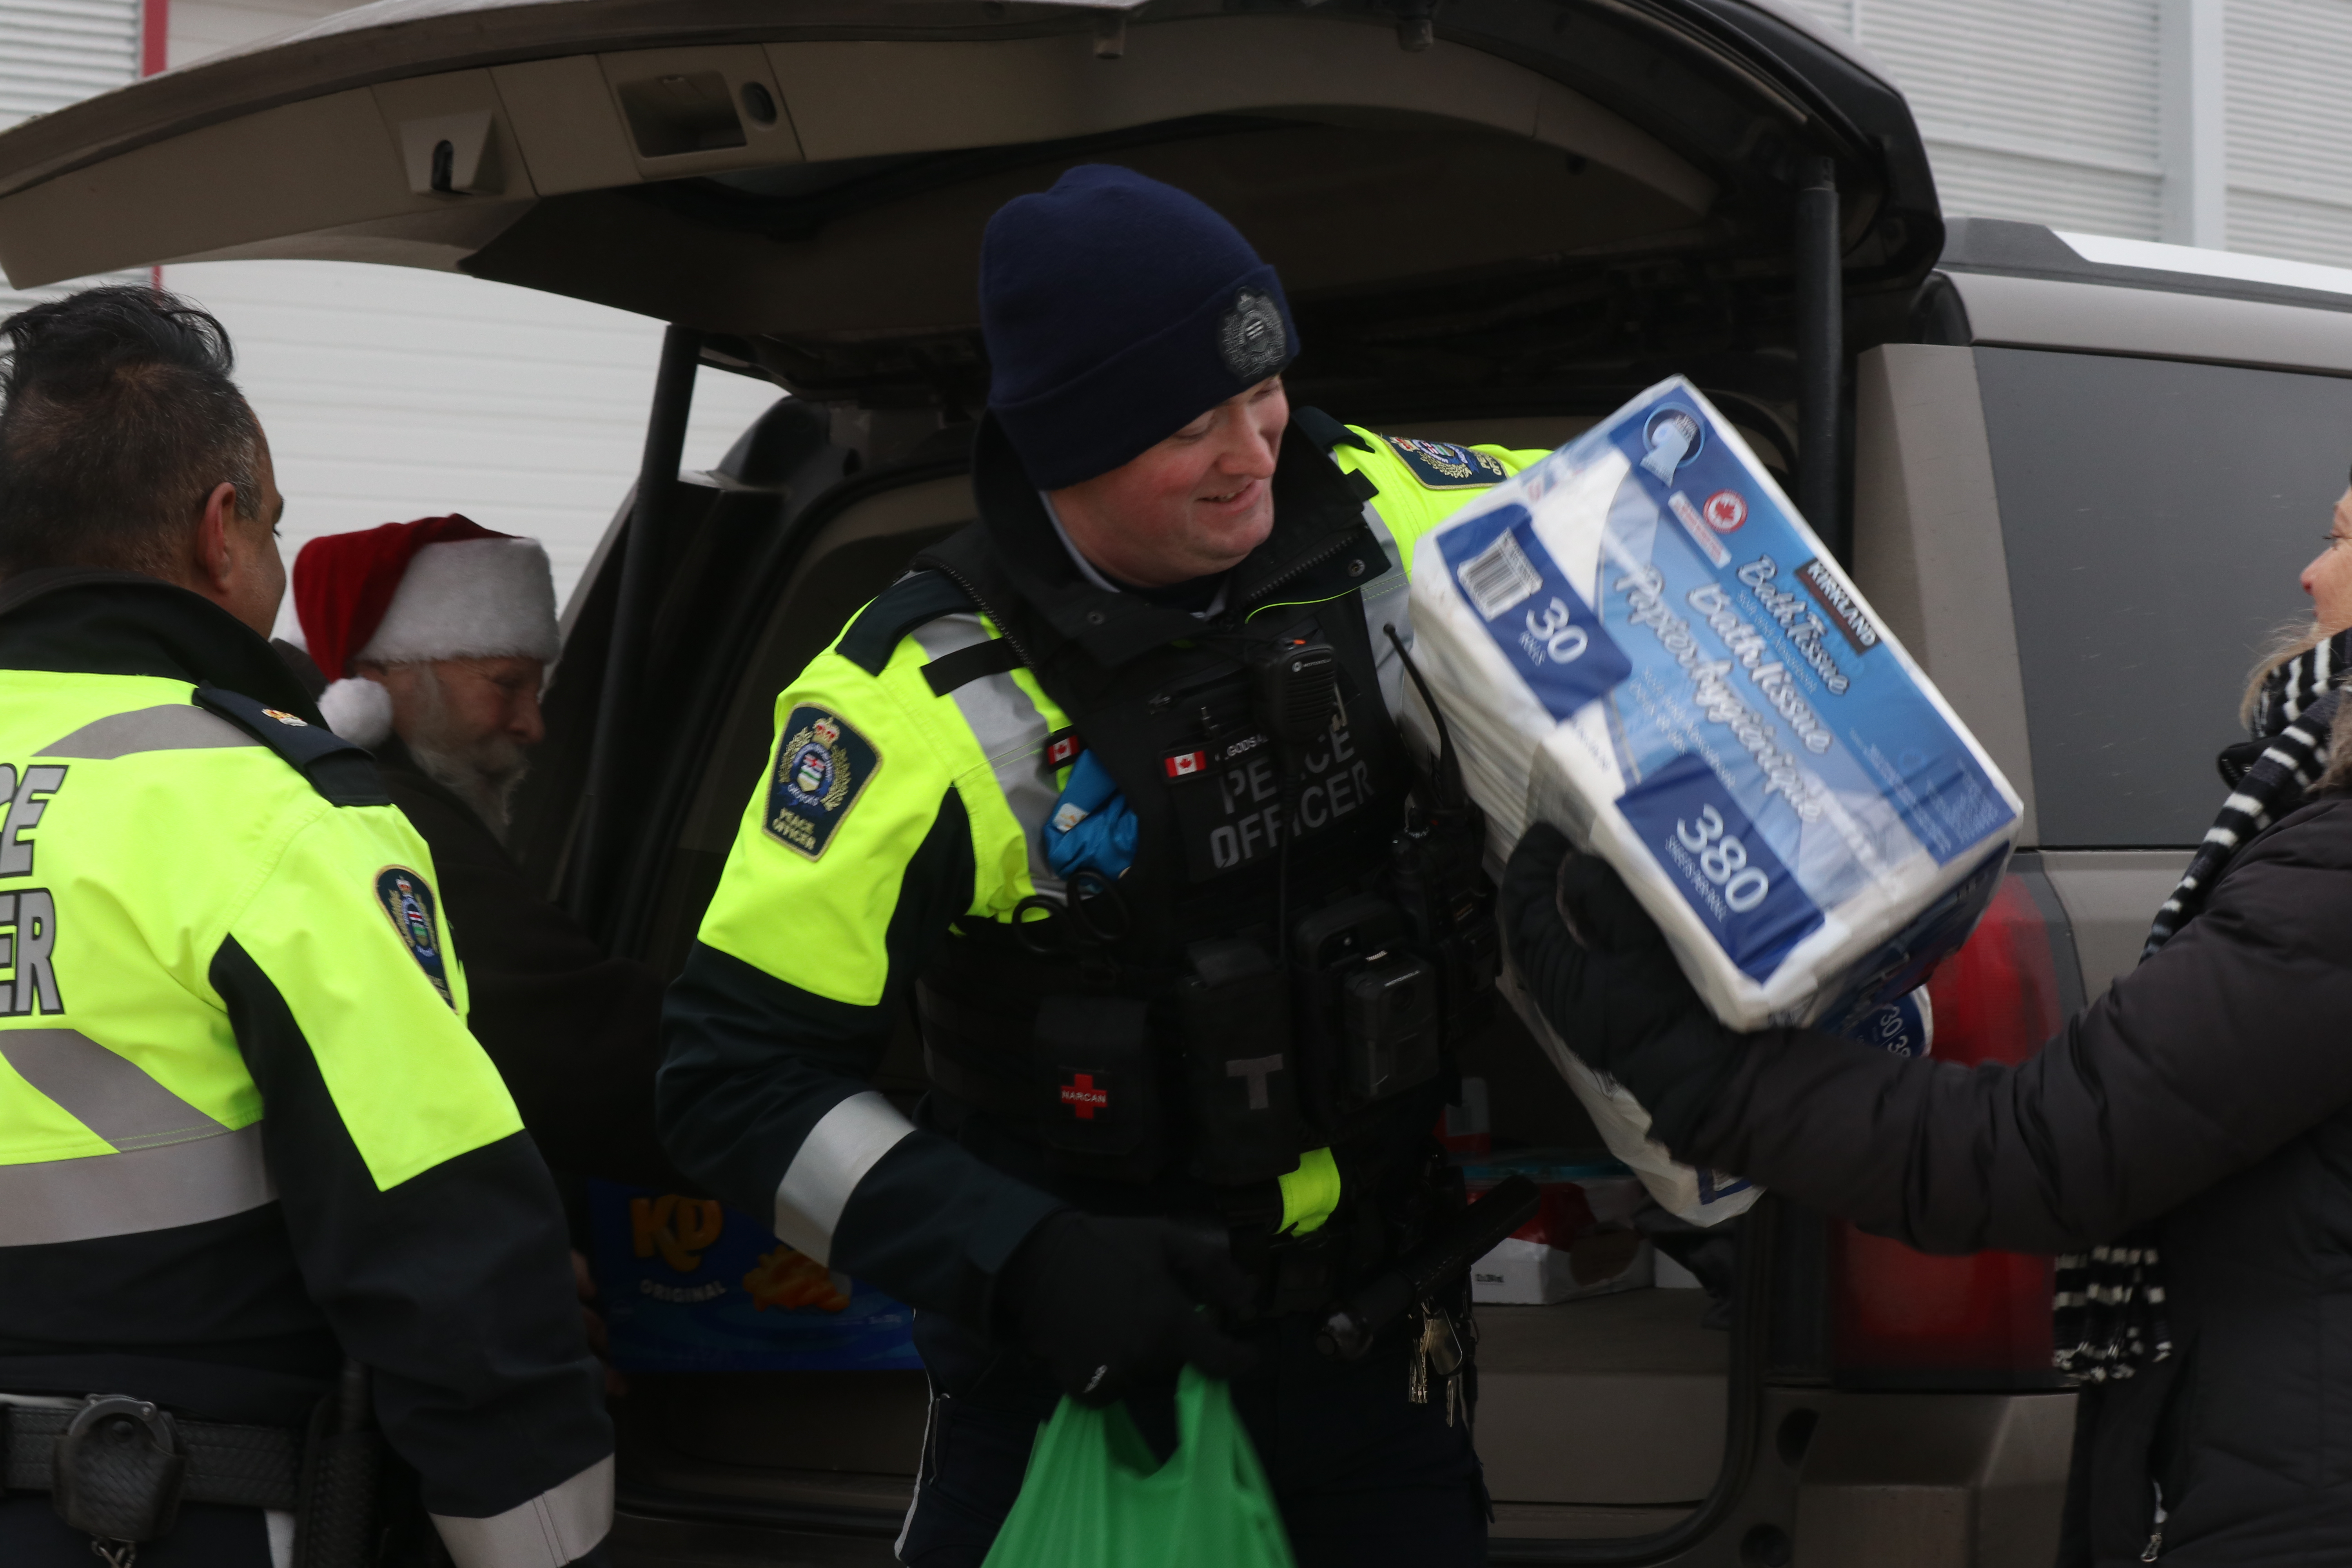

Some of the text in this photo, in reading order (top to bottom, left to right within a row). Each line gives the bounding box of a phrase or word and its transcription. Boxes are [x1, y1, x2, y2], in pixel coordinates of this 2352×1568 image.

[1526, 597, 1588, 664] 30
[1615, 564, 1698, 668] Papier
[1736, 553, 1849, 695] Bath Tissue
[1807, 561, 1877, 647] KIRKLAND
[1689, 583, 1766, 668] Bath
[1751, 662, 1832, 753] Tissue
[1218, 724, 1355, 815] PECE
[1677, 803, 1769, 913] 380
[1880, 1006, 1903, 1037] 30
[1060, 1089, 1107, 1104] NARCAN
[1226, 1053, 1283, 1111] T
[630, 1194, 724, 1272] KD
[640, 1279, 728, 1304] ORIGINAL
